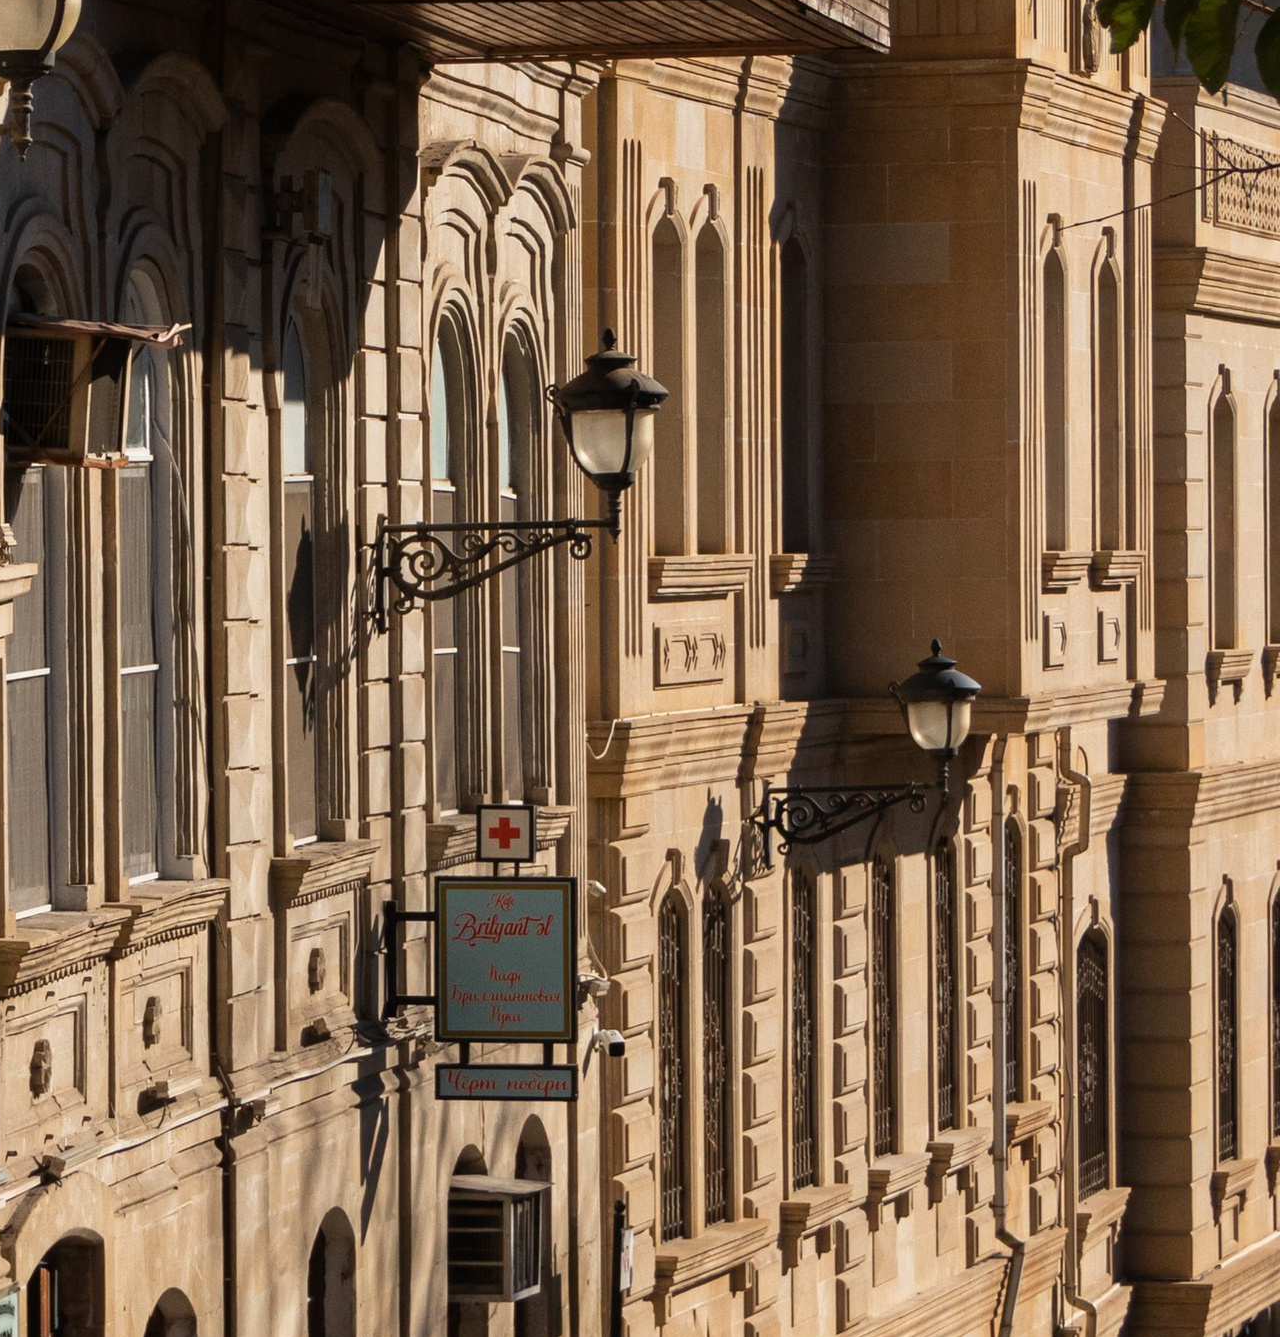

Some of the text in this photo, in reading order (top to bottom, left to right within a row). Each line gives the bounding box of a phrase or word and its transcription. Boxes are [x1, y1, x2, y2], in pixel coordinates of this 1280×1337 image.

[452, 912, 541, 947] Brilyant
[487, 963, 523, 990] Кафе
[490, 1004, 522, 1030] Рука
[506, 1071, 570, 1097] побери
